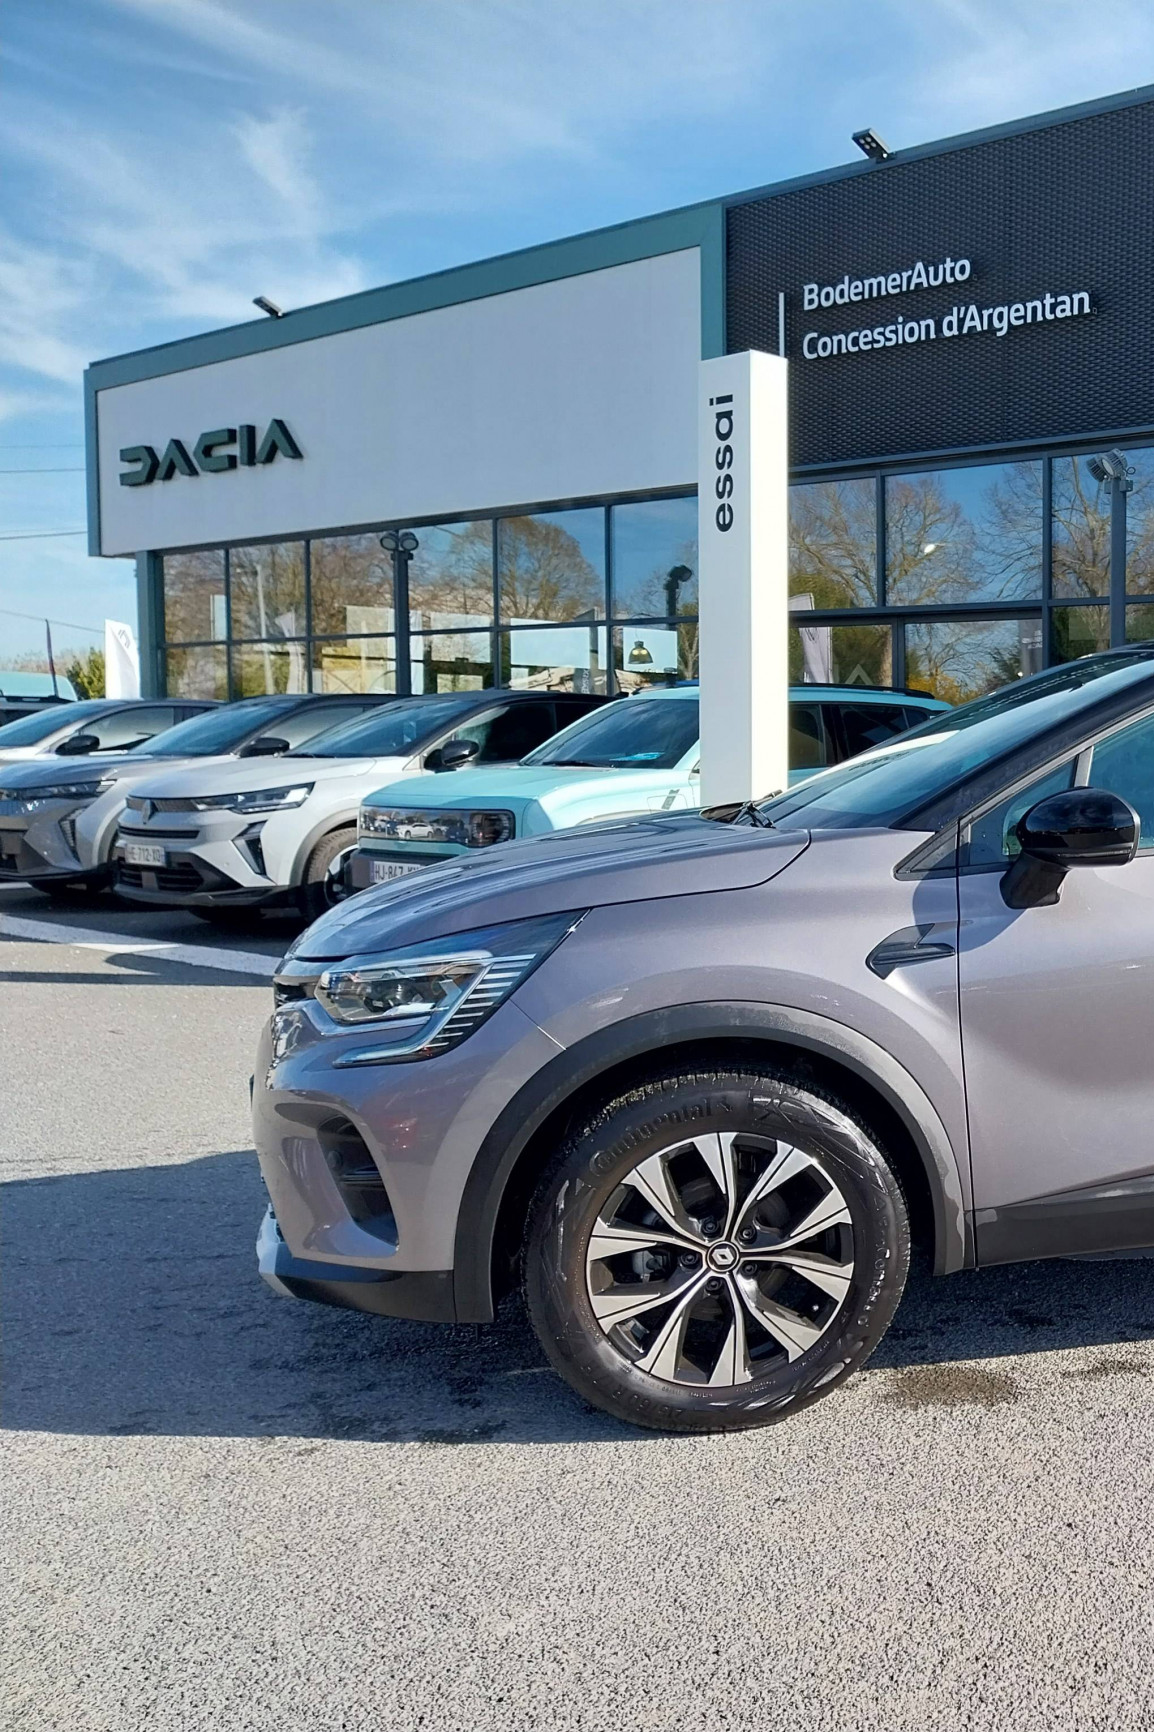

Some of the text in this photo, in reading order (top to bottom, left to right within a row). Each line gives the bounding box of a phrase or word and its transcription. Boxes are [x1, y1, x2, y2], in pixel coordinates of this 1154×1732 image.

[803, 257, 971, 311] BodemerAuto
[802, 315, 936, 360] Concession
[118, 418, 304, 488] DACIA
[709, 394, 734, 533] essai
